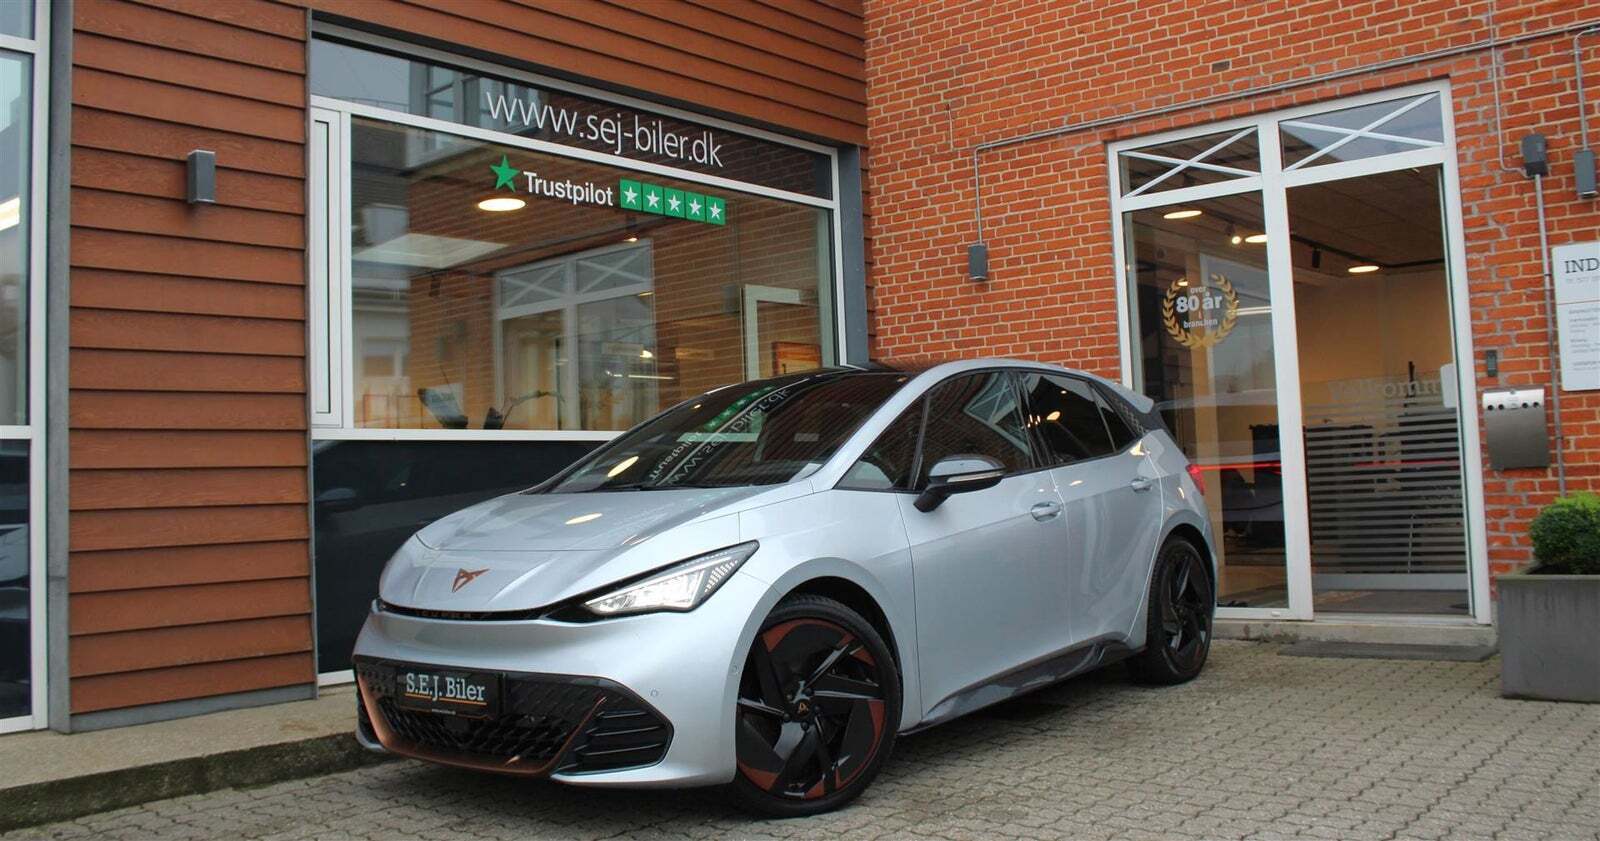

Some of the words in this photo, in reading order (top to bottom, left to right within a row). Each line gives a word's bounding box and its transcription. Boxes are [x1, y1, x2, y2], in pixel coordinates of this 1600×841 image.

[486, 92, 723, 167] www.sej-biler.dk
[523, 171, 614, 207] Trustpilot
[1176, 295, 1200, 313] 80
[1202, 291, 1223, 310] år
[406, 673, 443, 701] S.E.J.
[445, 677, 486, 701] Biler
